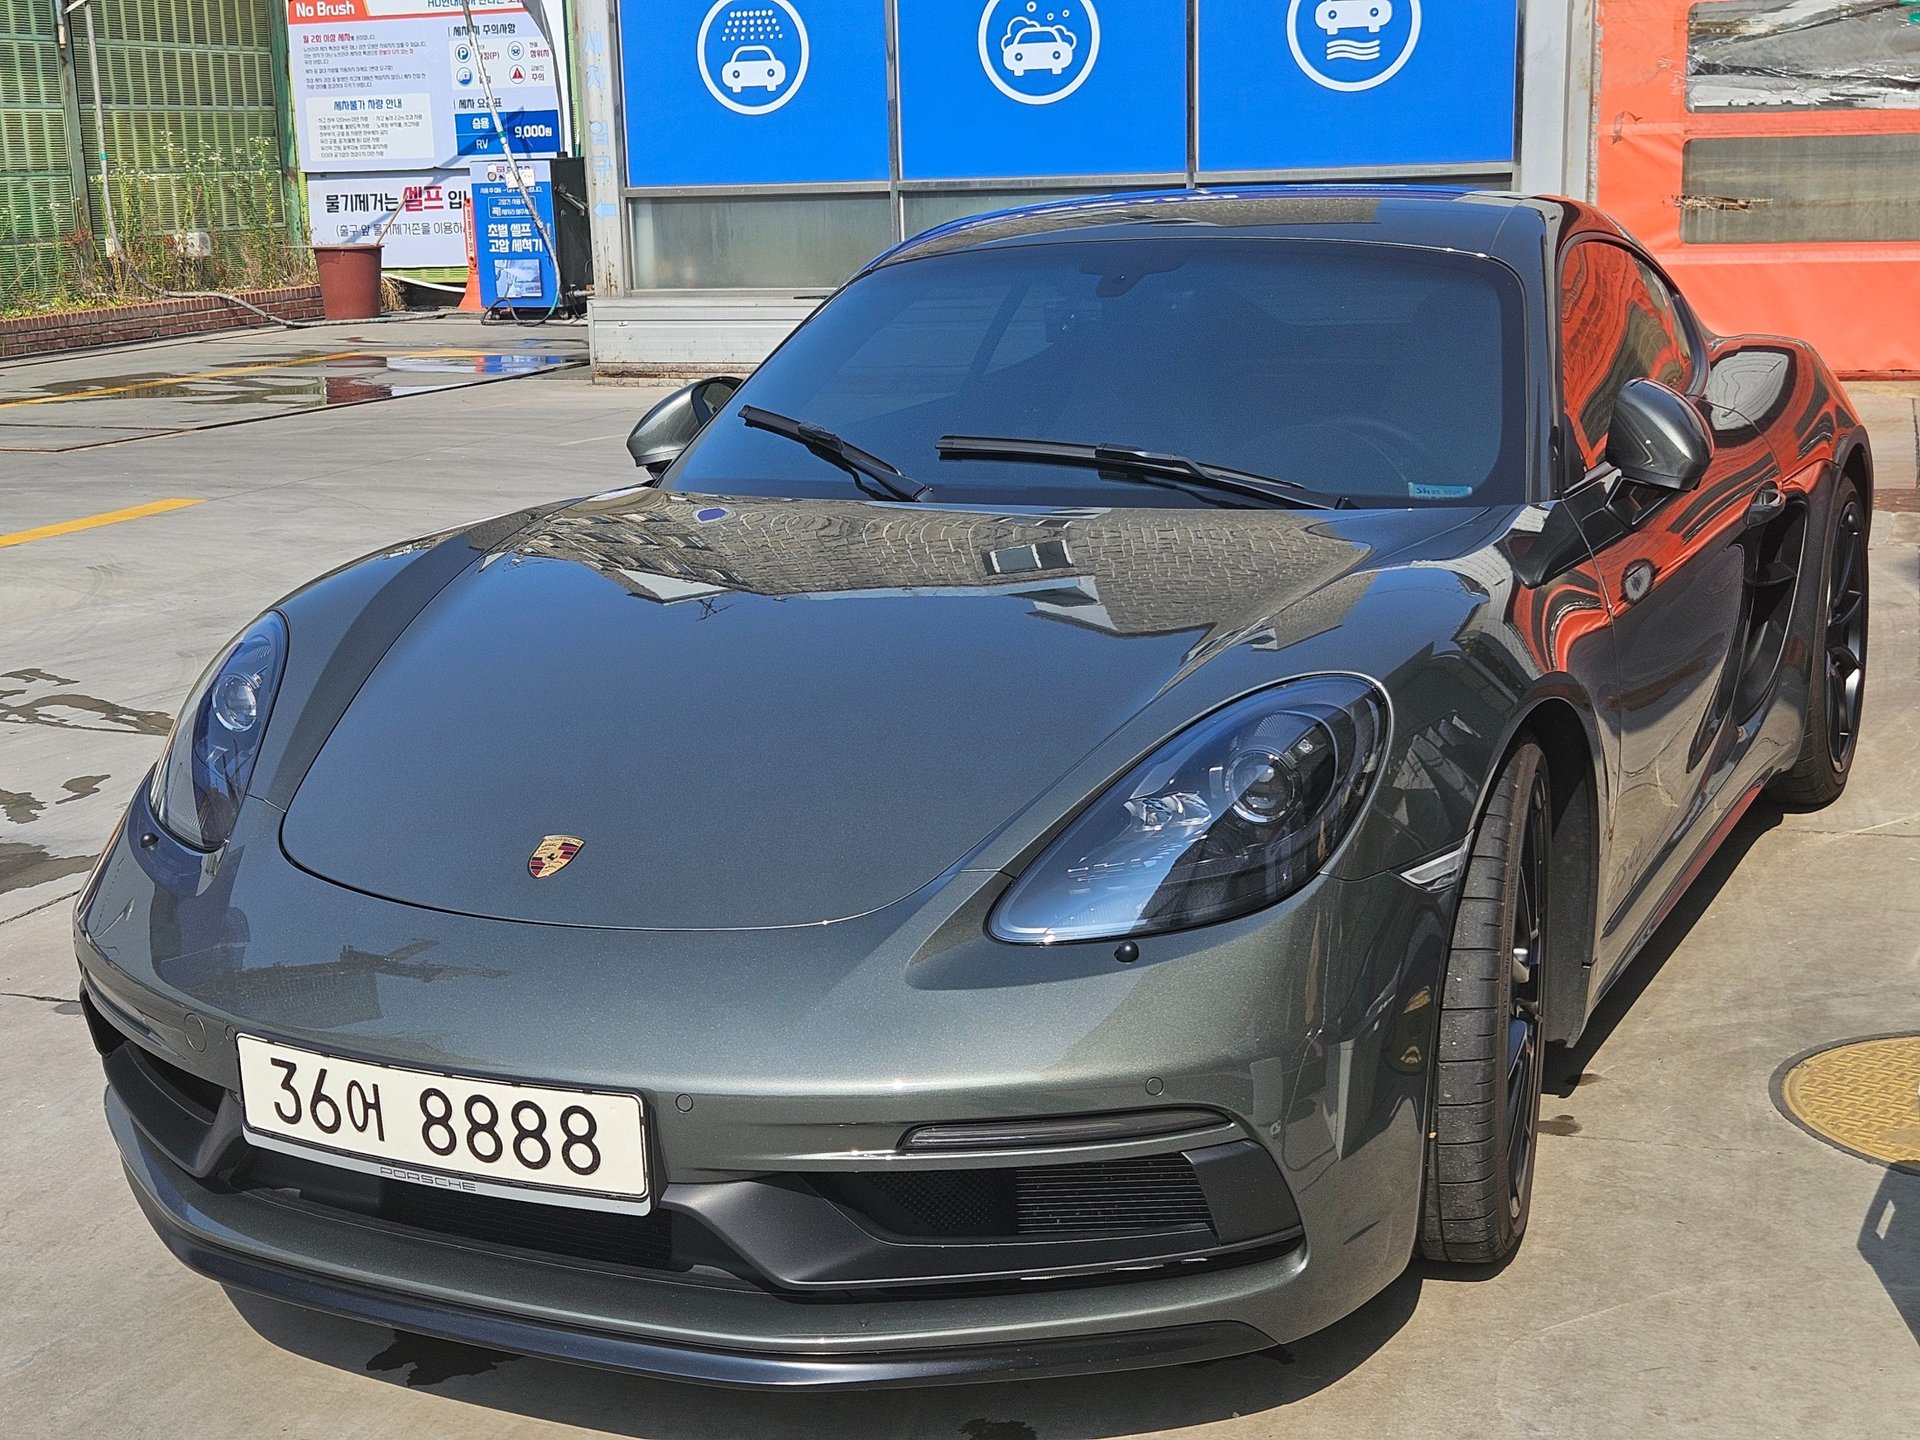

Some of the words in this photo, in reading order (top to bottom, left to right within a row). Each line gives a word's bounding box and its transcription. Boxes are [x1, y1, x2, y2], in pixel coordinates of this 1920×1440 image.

[295, 4, 314, 17] No
[317, 1, 355, 17] Brush
[482, 23, 516, 35] 주의사항
[323, 34, 336, 42] 이상
[531, 73, 545, 81] 주의
[333, 100, 365, 111] 세차불가
[367, 99, 383, 110] 차량
[385, 98, 403, 109] 안내
[459, 99, 475, 109] 세차
[472, 117, 490, 129] 승용
[514, 125, 553, 139] 9,000원
[476, 139, 489, 149] RV
[325, 193, 399, 213] 물기제거는
[403, 185, 444, 212] 셀프
[447, 190, 467, 209] 입
[335, 224, 357, 237] (출구
[361, 224, 370, 237] 앞
[373, 222, 431, 237] 물기제거존을
[433, 222, 465, 234] 이용하
[488, 223, 508, 238] 초벌
[510, 223, 532, 238] 셀프
[488, 239, 510, 253] 고압
[511, 238, 543, 253] 세척기
[269, 1056, 386, 1142] 36어
[418, 1086, 602, 1176] 8888
[380, 1166, 477, 1192] PORSCHE
